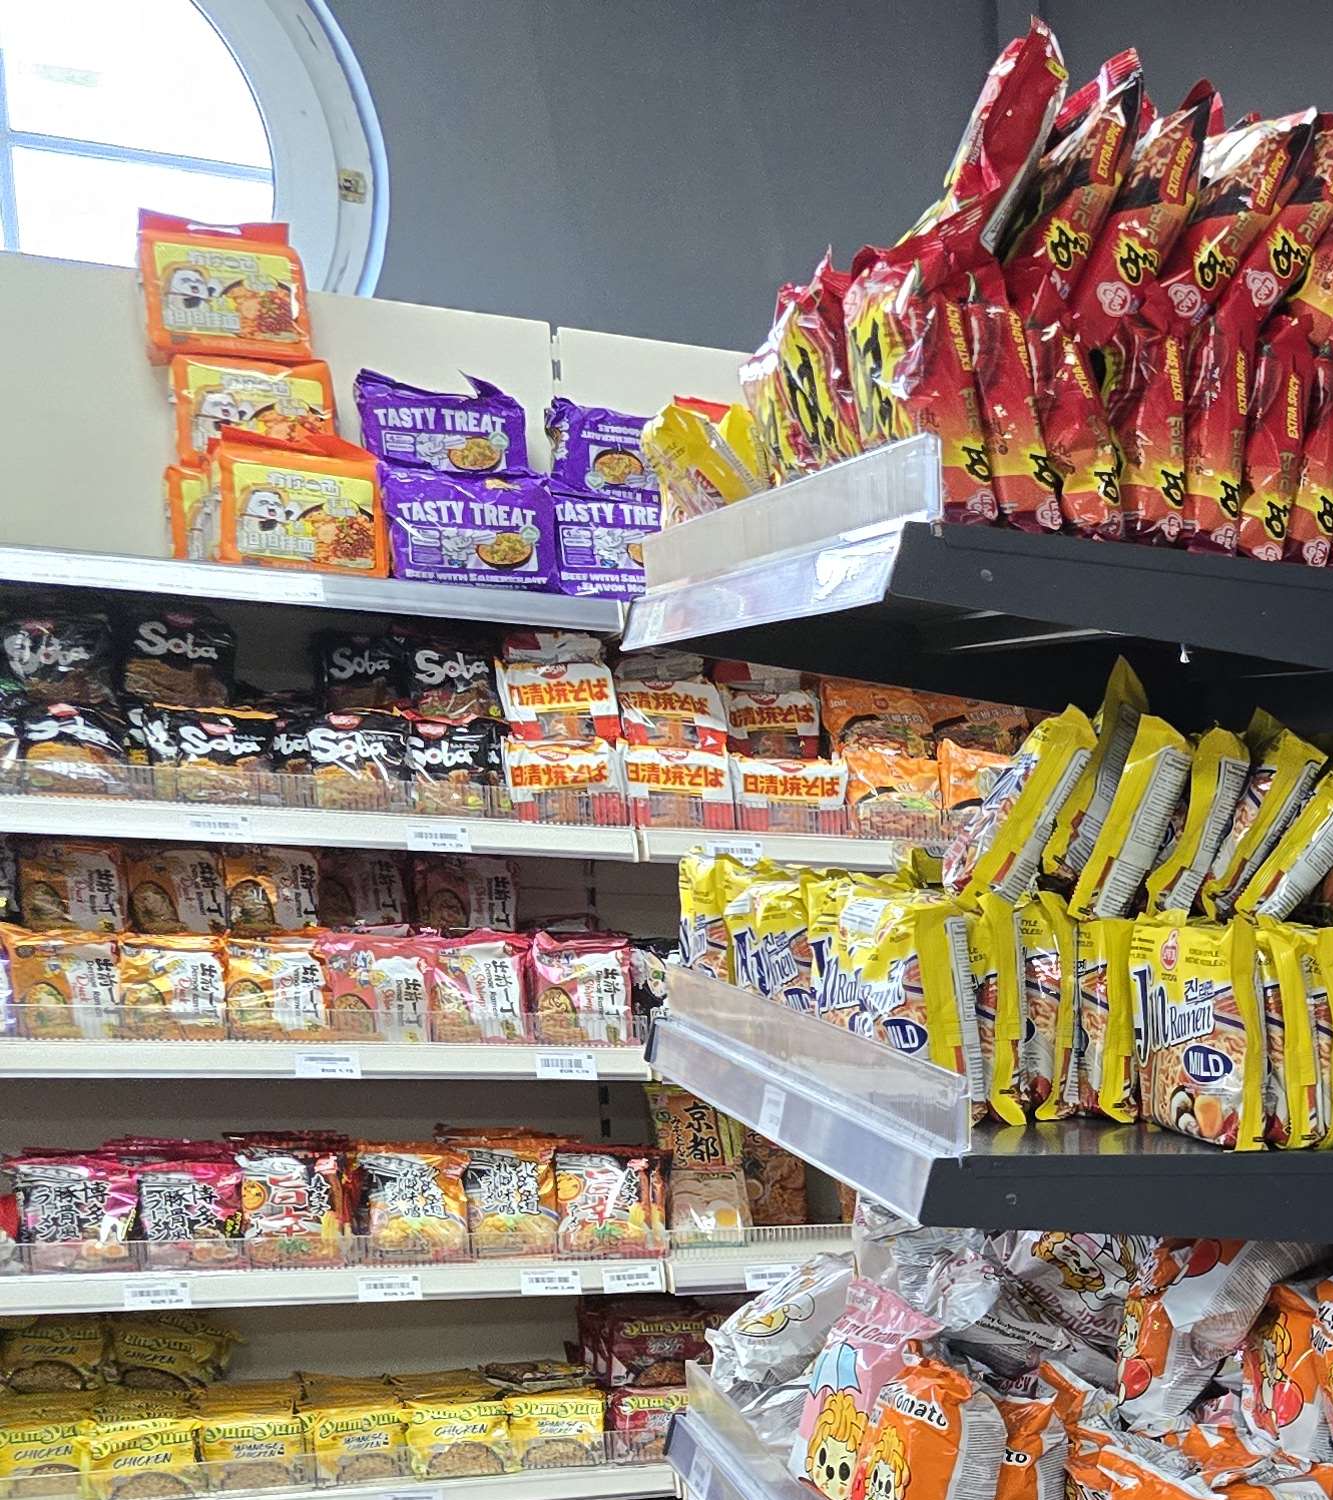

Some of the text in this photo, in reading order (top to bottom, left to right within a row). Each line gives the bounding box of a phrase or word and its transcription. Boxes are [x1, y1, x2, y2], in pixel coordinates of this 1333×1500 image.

[1165, 137, 1194, 199] EXTRA SPICY
[374, 408, 506, 433] TASTY TREAT
[398, 501, 536, 526] TASTY TREAT
[556, 500, 614, 522] TASTY
[414, 650, 489, 684] Soba
[509, 678, 610, 706] 日清焼そば
[178, 725, 261, 756] Soba
[309, 727, 387, 765] Soba
[404, 737, 474, 767] Soba
[511, 762, 607, 787] 日清焼そば
[627, 761, 724, 788] 日清焼そば
[743, 773, 841, 798] 日清焼そば
[1132, 964, 1214, 1066] Jin Ramen
[1188, 1049, 1225, 1080] MILD
[684, 1101, 720, 1163] 京都
[433, 1423, 488, 1437] CHICKEN
[14, 1446, 73, 1460] CHICKEN
[113, 1453, 172, 1469] CHICKEN
